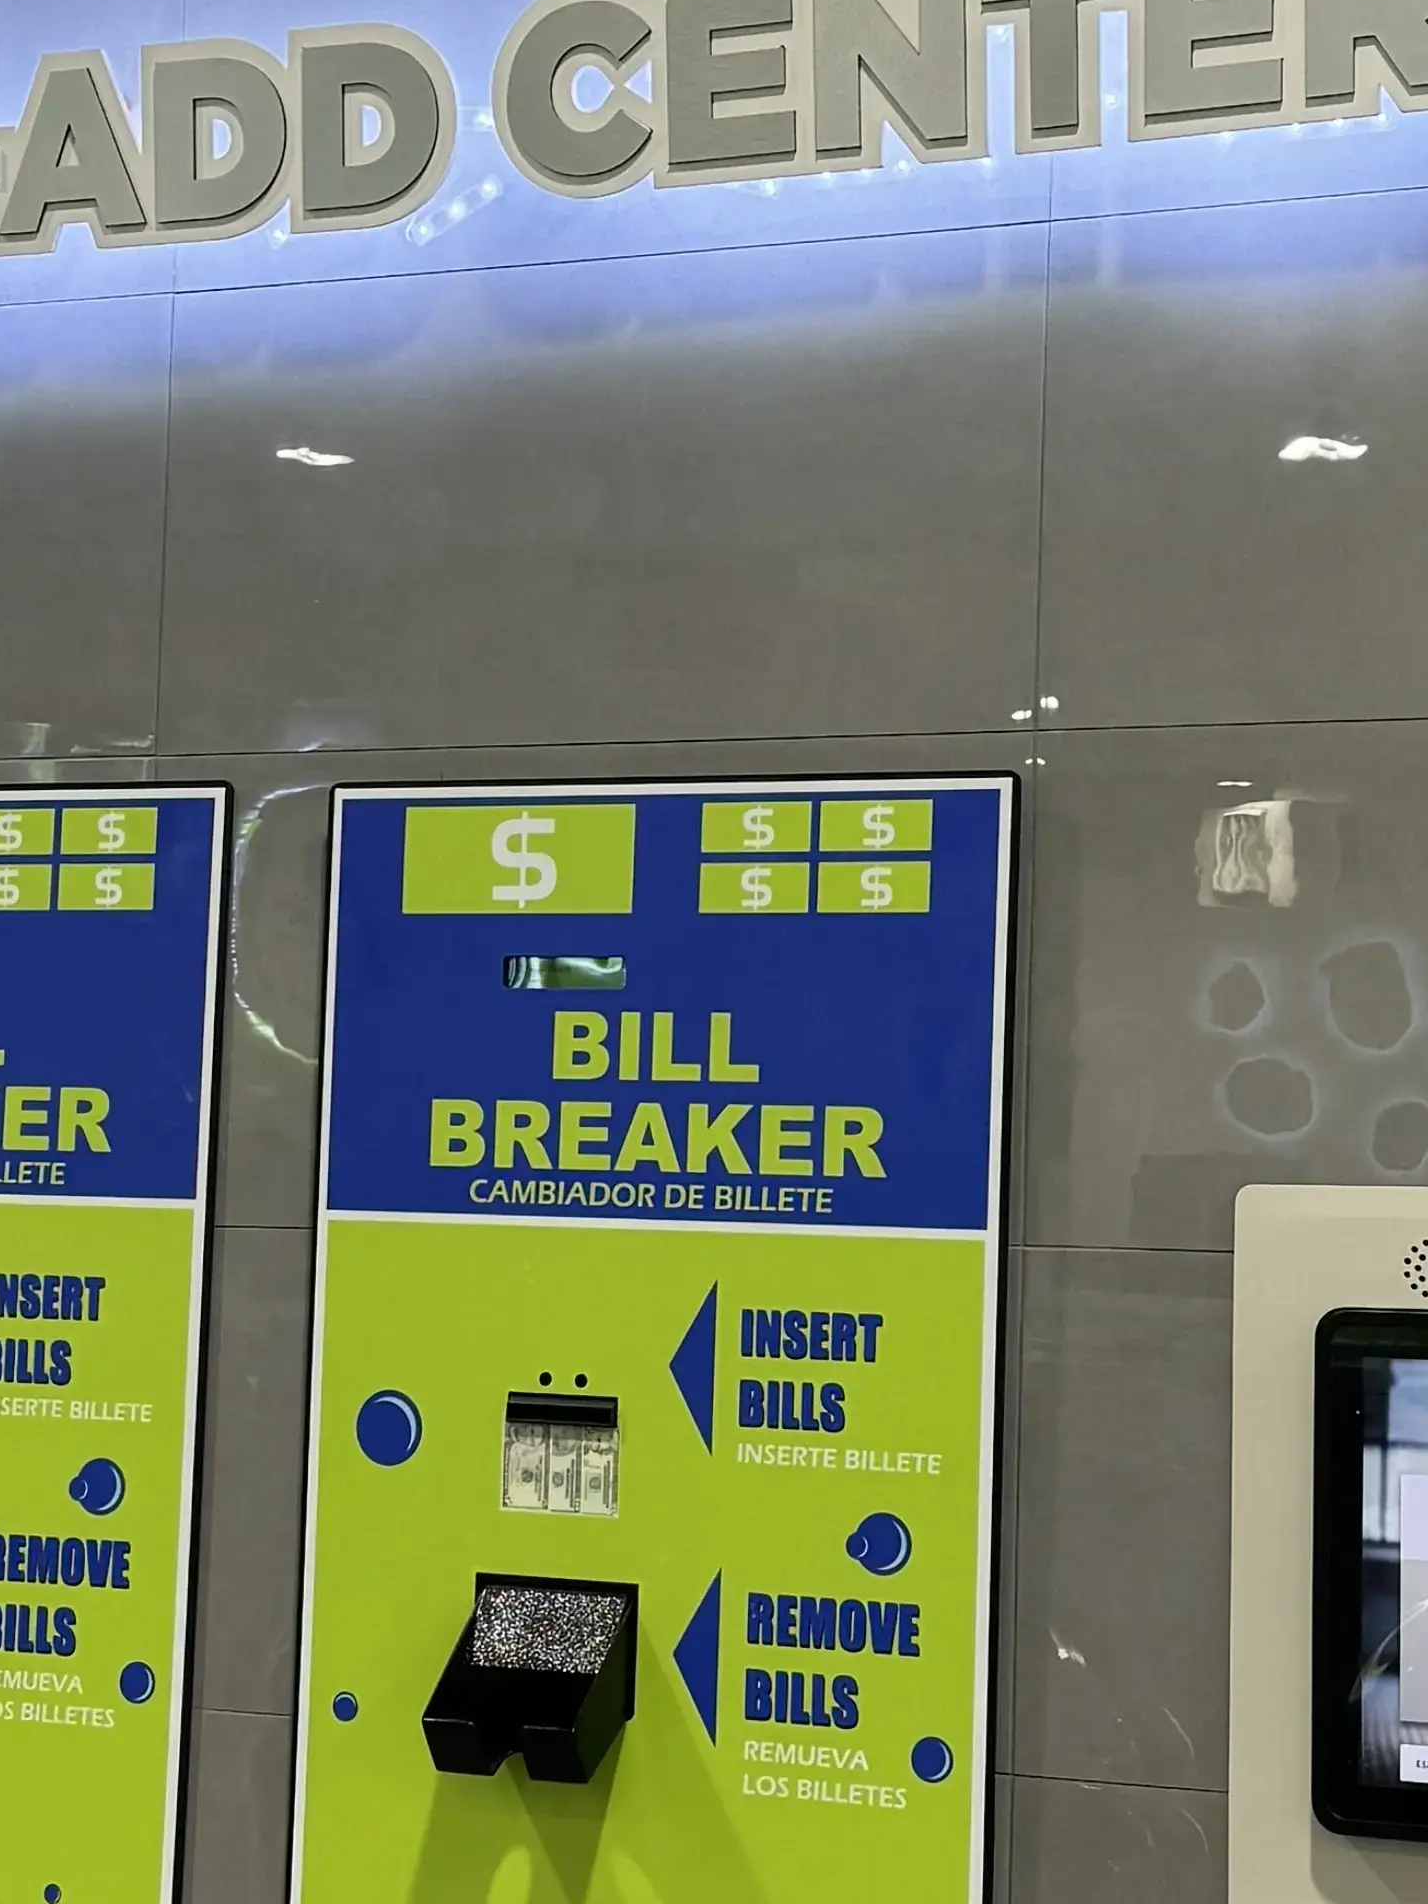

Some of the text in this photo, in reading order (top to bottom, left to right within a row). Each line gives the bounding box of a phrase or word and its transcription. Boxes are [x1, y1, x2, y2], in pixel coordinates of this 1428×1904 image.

[553, 1011, 759, 1082] BILL
[429, 1099, 886, 1179] BREAKER
[469, 1179, 833, 1213] CAMBIADOR DE BILLETE
[741, 1308, 883, 1363] INSERT
[70, 1400, 153, 1423] BILLETE
[738, 1380, 845, 1433] BILLS
[737, 1442, 942, 1475] INSERTE BILLETE
[747, 1591, 921, 1657] REMOVE
[21, 1702, 115, 1728] BILLETES
[744, 1668, 859, 1729] BILLS
[744, 1741, 869, 1771] REMUEVA
[743, 1774, 907, 1809] LOS BILLETES
